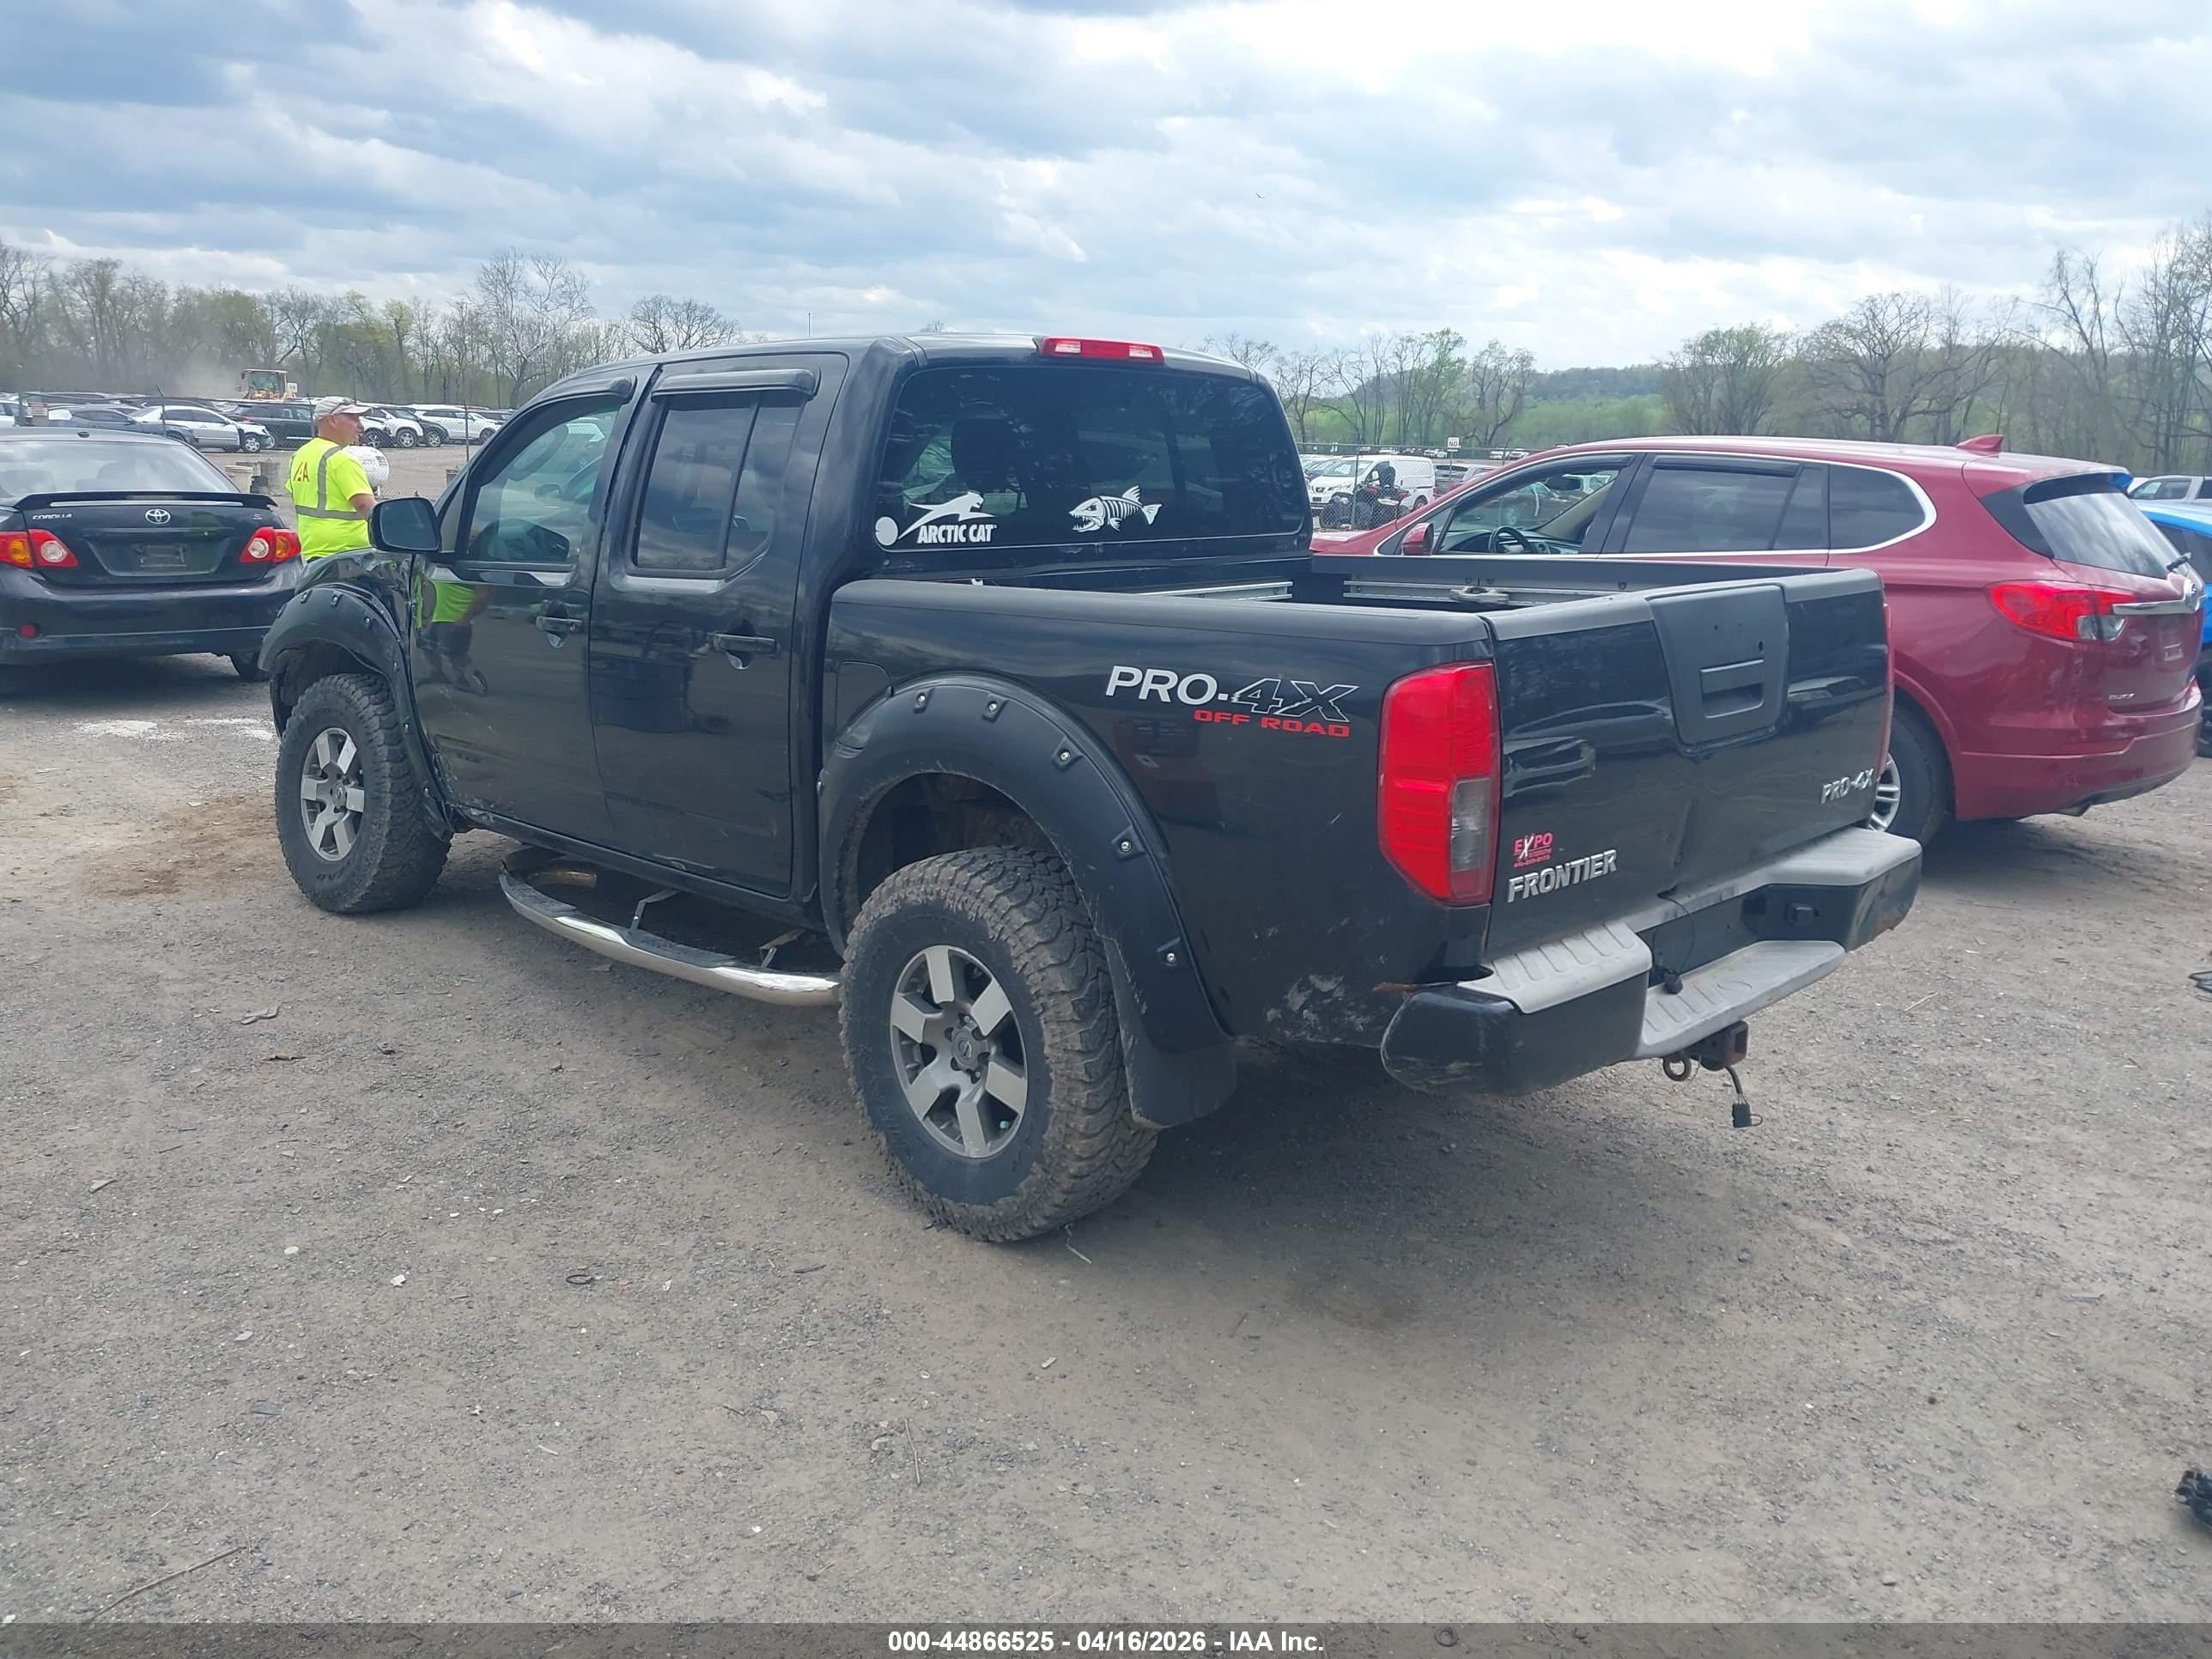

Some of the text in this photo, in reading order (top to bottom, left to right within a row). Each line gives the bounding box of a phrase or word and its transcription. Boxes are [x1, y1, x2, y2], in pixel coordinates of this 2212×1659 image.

[916, 524, 995, 544] ARCTIC CAT
[1194, 708, 1351, 738] OFF ROAD
[1820, 768, 1875, 805] PRO-4X
[1514, 832, 1553, 860] EXPO
[1507, 848, 1617, 903] FRONTIER
